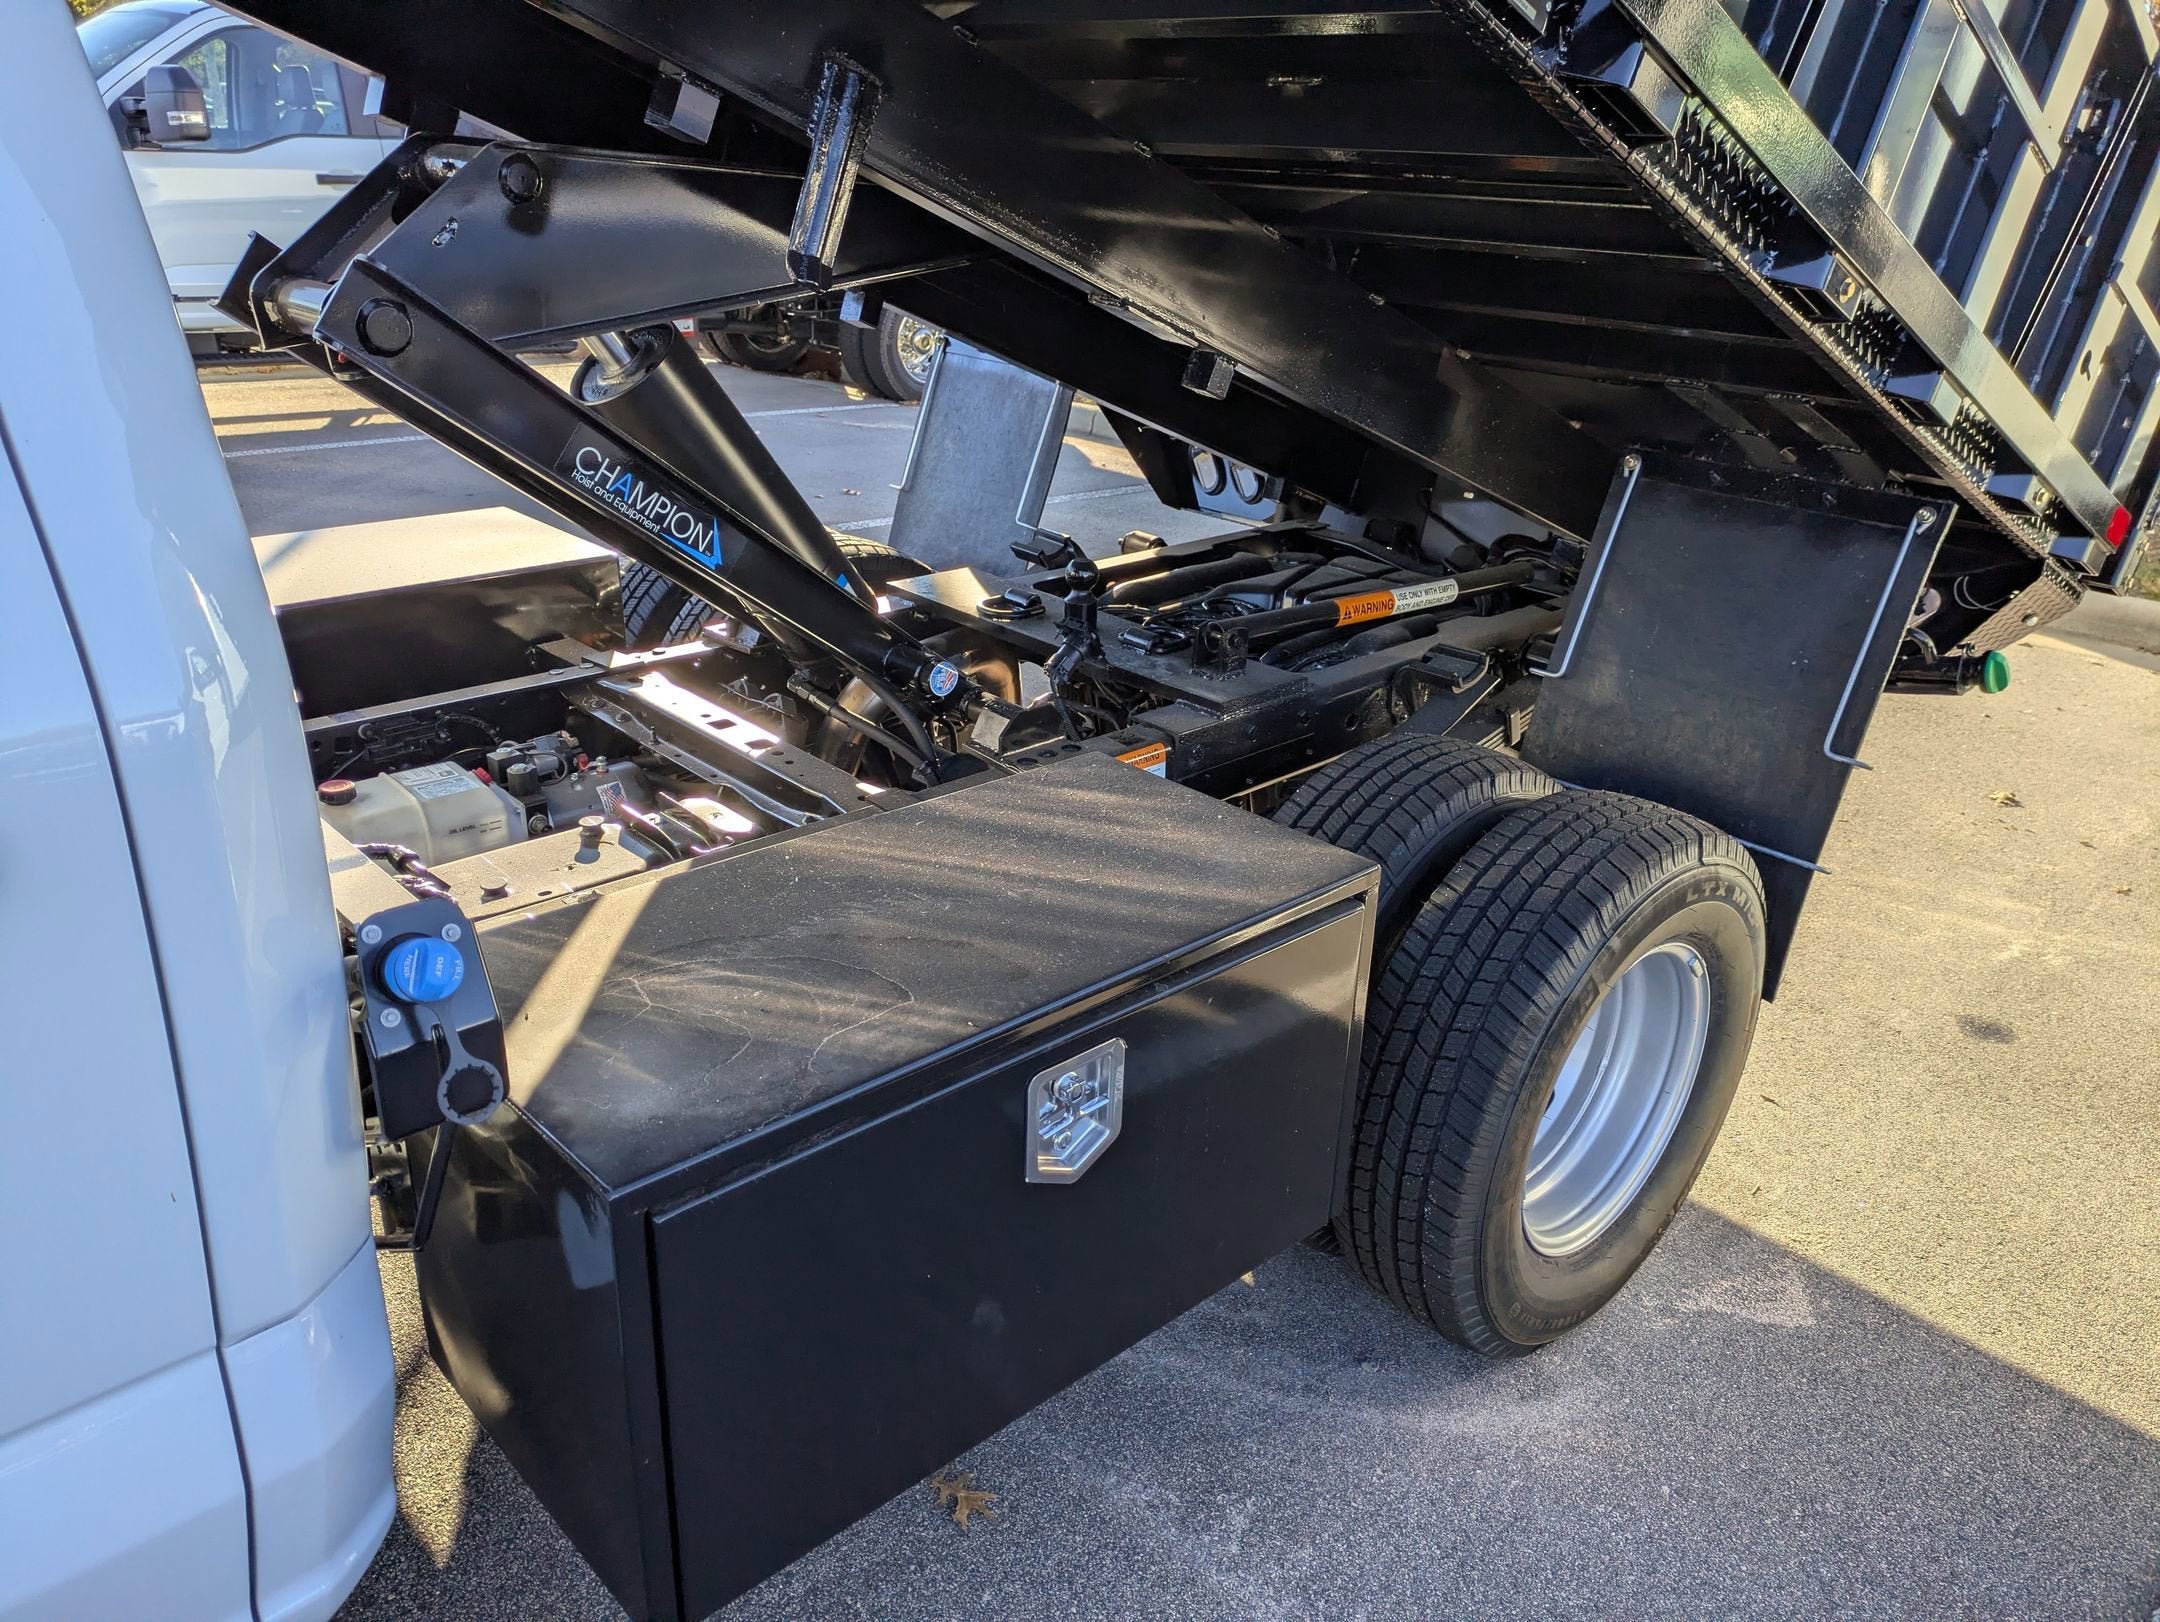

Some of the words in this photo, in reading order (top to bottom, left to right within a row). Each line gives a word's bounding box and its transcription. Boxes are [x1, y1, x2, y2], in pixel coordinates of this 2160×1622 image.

[571, 469, 595, 490] Hoist
[594, 484, 615, 503] and
[613, 496, 661, 534] Equipment
[575, 446, 713, 553] CHAMPION
[1396, 592, 1408, 602] USE
[1408, 590, 1423, 600] ONLY
[1424, 588, 1438, 597] WITH
[1438, 583, 1456, 594] EMPTY
[1352, 598, 1394, 617] WARNING
[1411, 600, 1424, 609] AND
[459, 824, 475, 832] LEVEL
[403, 954, 414, 979] HERE
[435, 956, 444, 977] DEF
